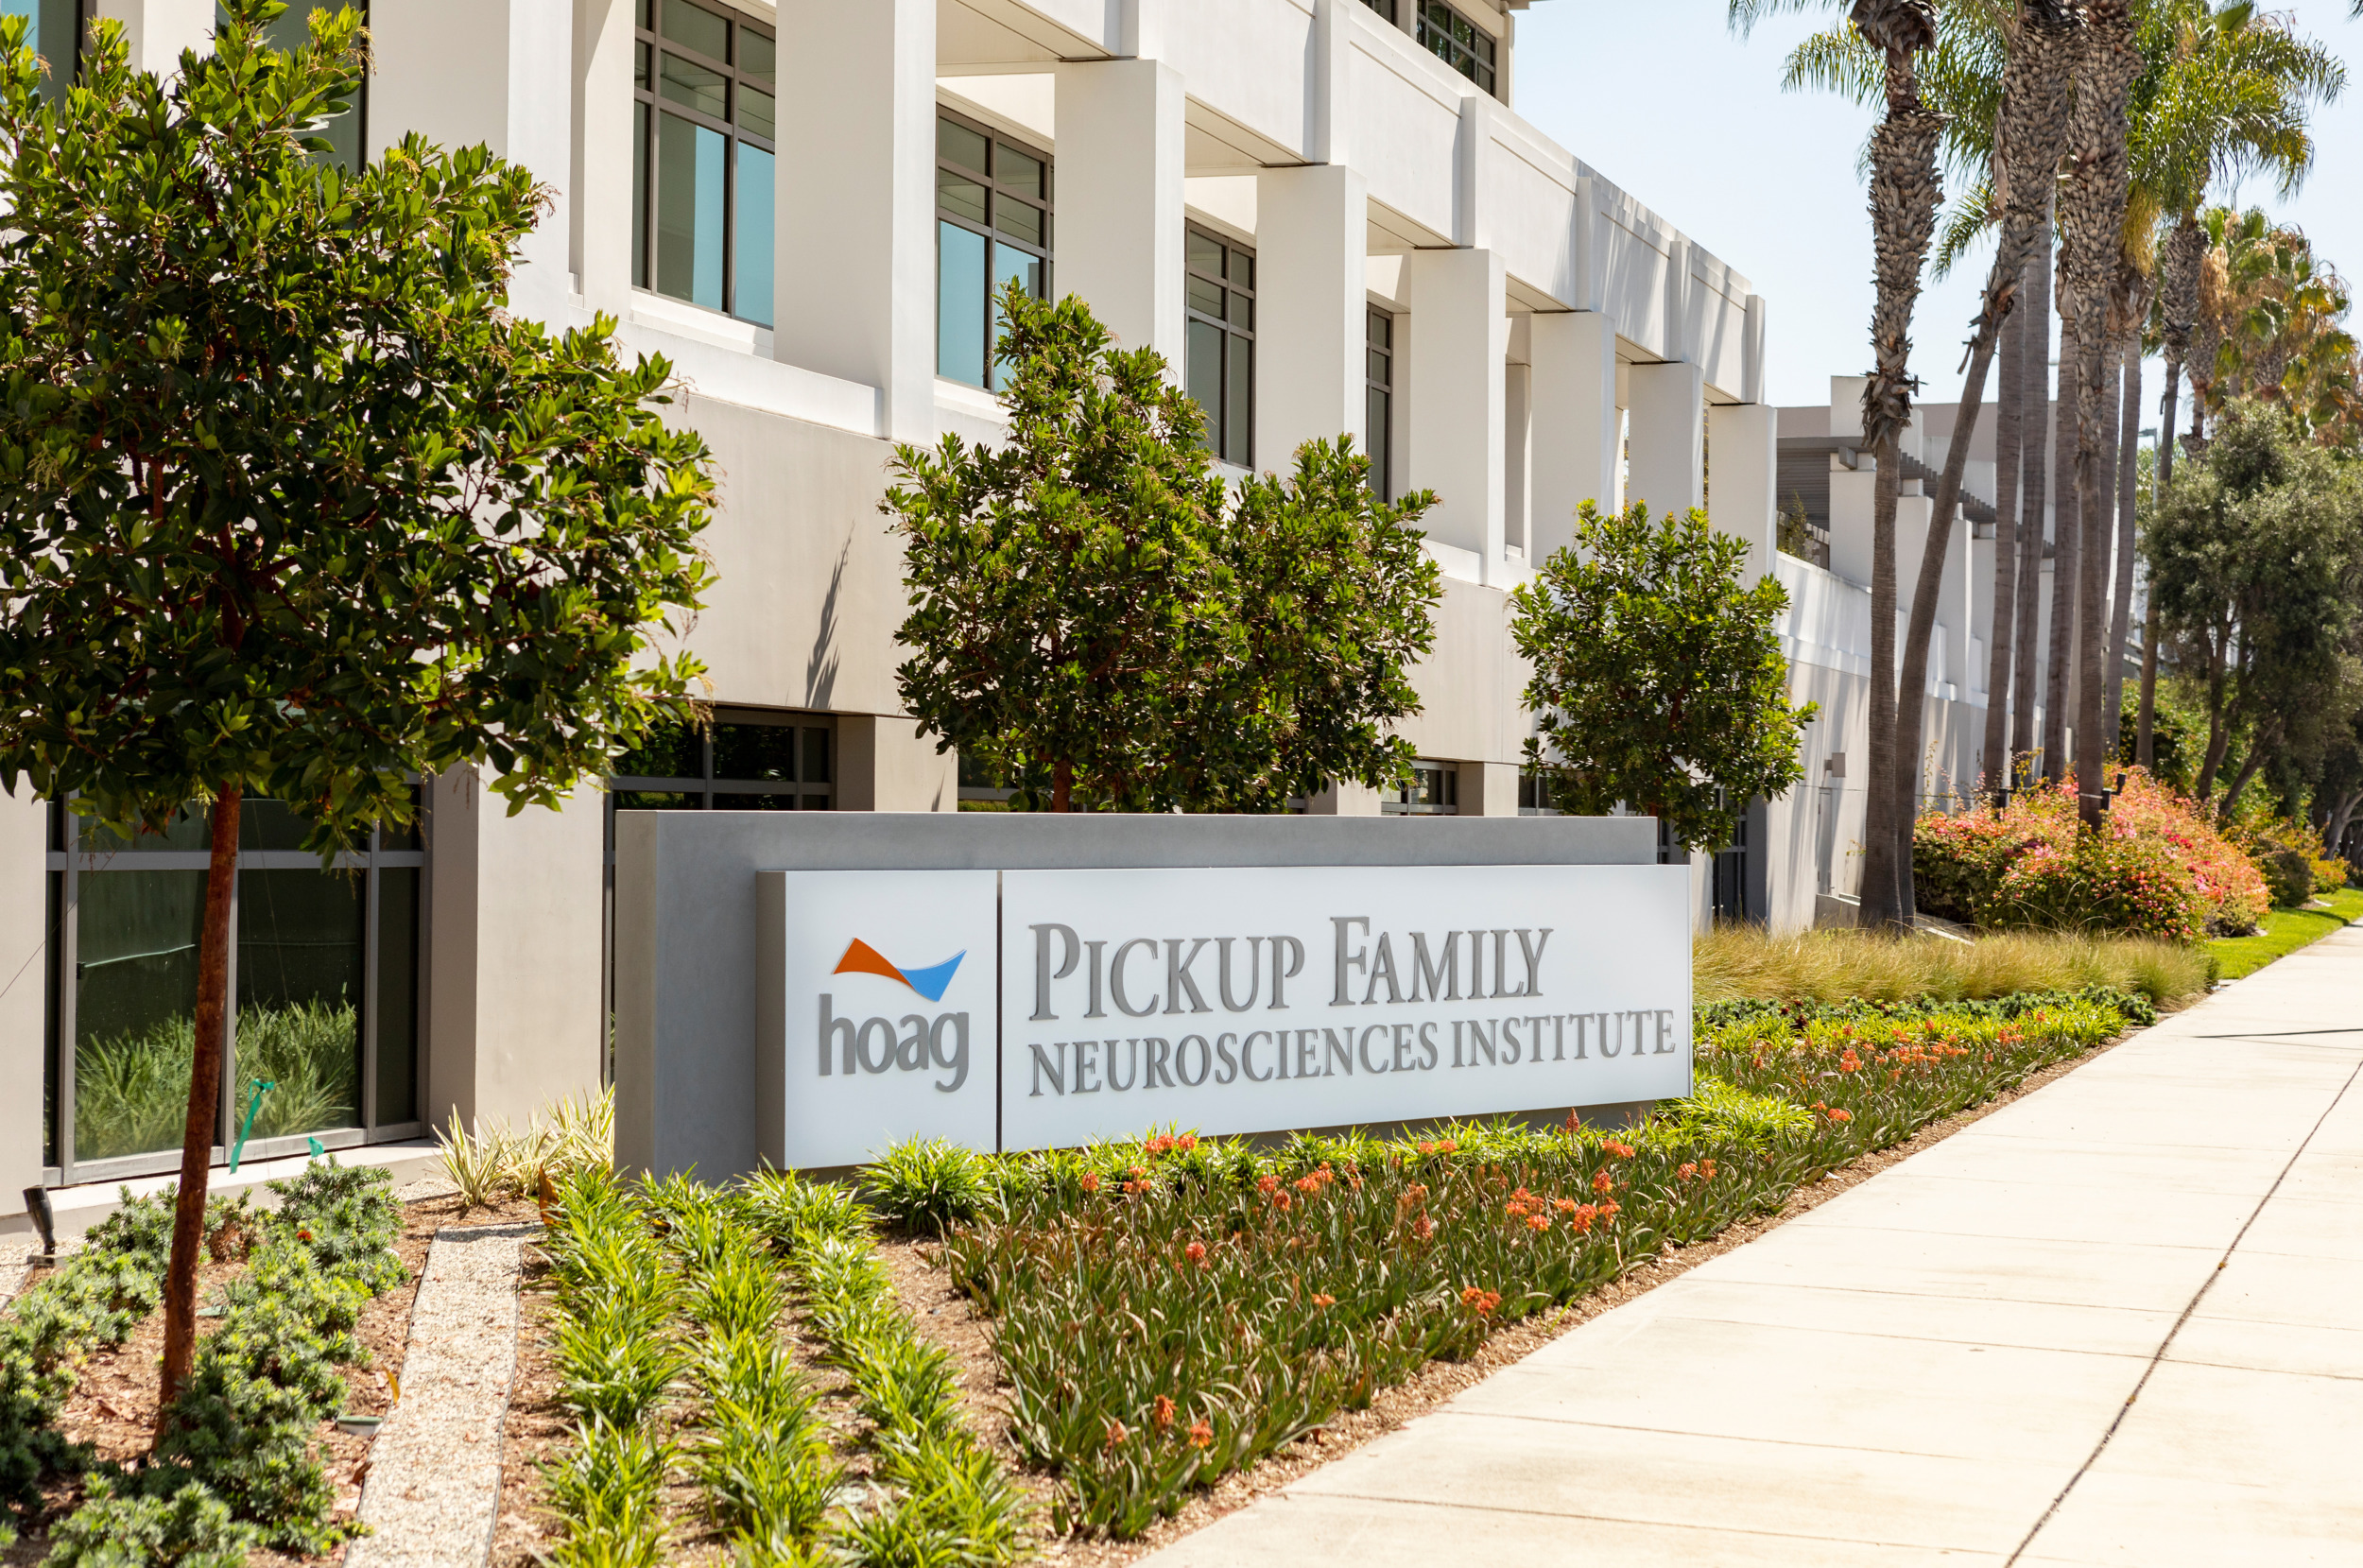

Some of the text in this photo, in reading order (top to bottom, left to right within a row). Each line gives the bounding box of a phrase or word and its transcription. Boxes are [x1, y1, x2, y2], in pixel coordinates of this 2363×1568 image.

[1028, 916, 1555, 1022] PICKUP FAMILY
[819, 992, 970, 1094] hoag
[1028, 1009, 1677, 1097] NEUROSCIENCES INSTITUTE
